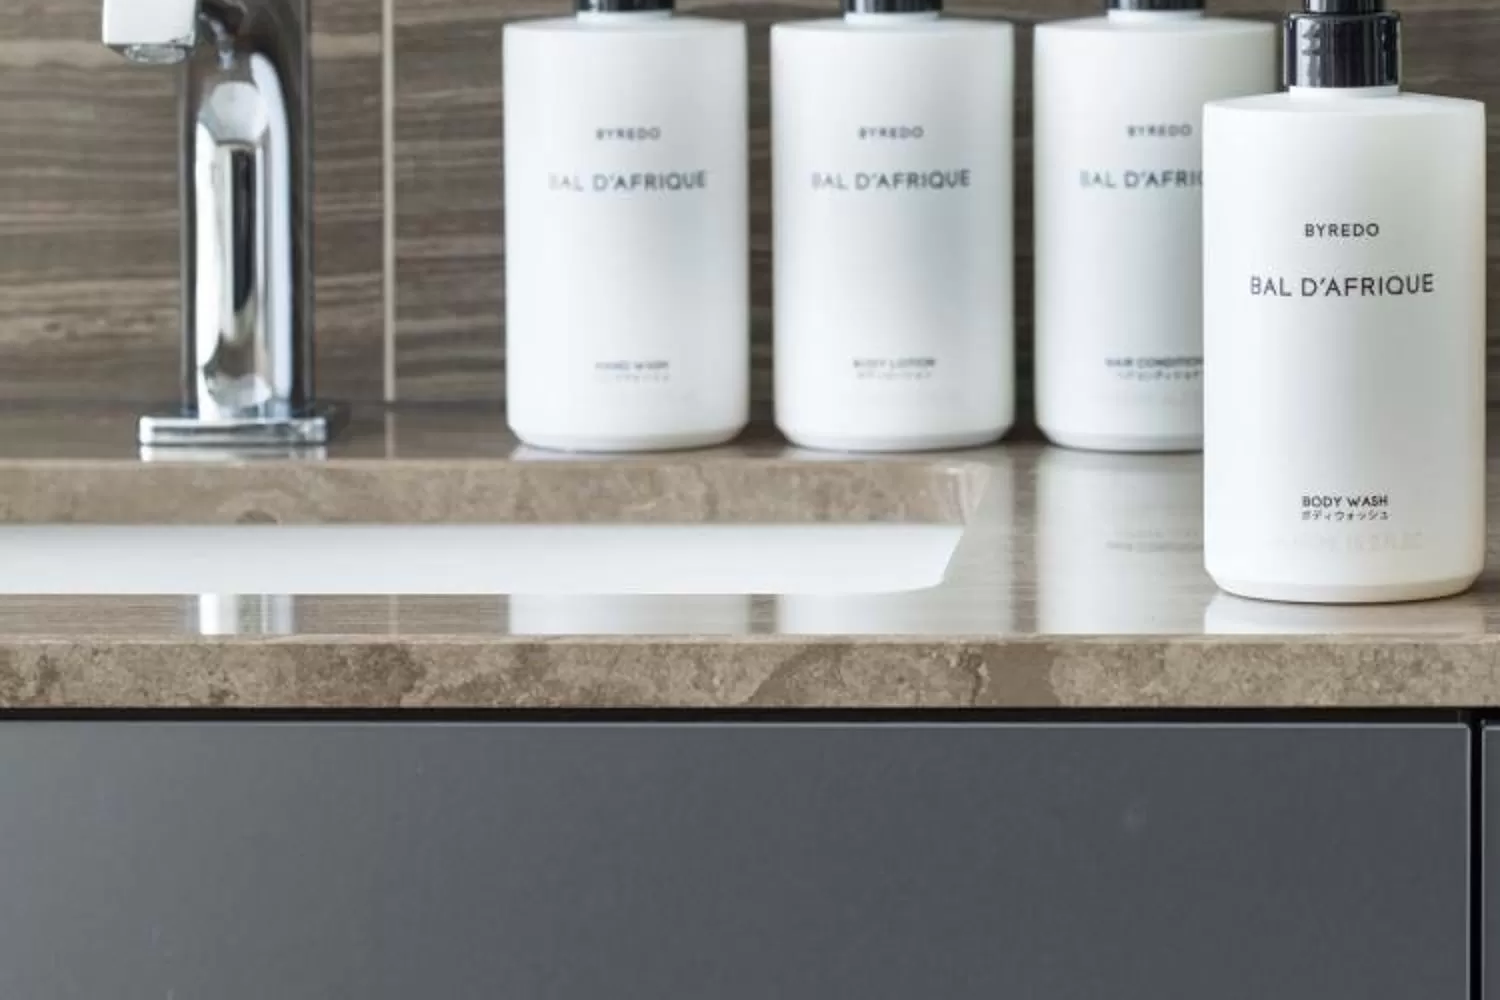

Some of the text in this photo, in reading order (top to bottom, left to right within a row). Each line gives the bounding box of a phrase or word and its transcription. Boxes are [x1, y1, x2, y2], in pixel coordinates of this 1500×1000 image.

[595, 127, 661, 140] BYREDO
[858, 126, 924, 139] BYREDO
[1127, 124, 1193, 137] BYREDO
[592, 170, 707, 191] D'AFRIQUE
[811, 169, 971, 190] BAL D'AFRIQUE
[1079, 170, 1116, 188] BAL
[1305, 223, 1380, 237] BYREDO
[1251, 273, 1434, 297] BAL D'AFRIQUE
[1302, 495, 1389, 508] BODY WASH
